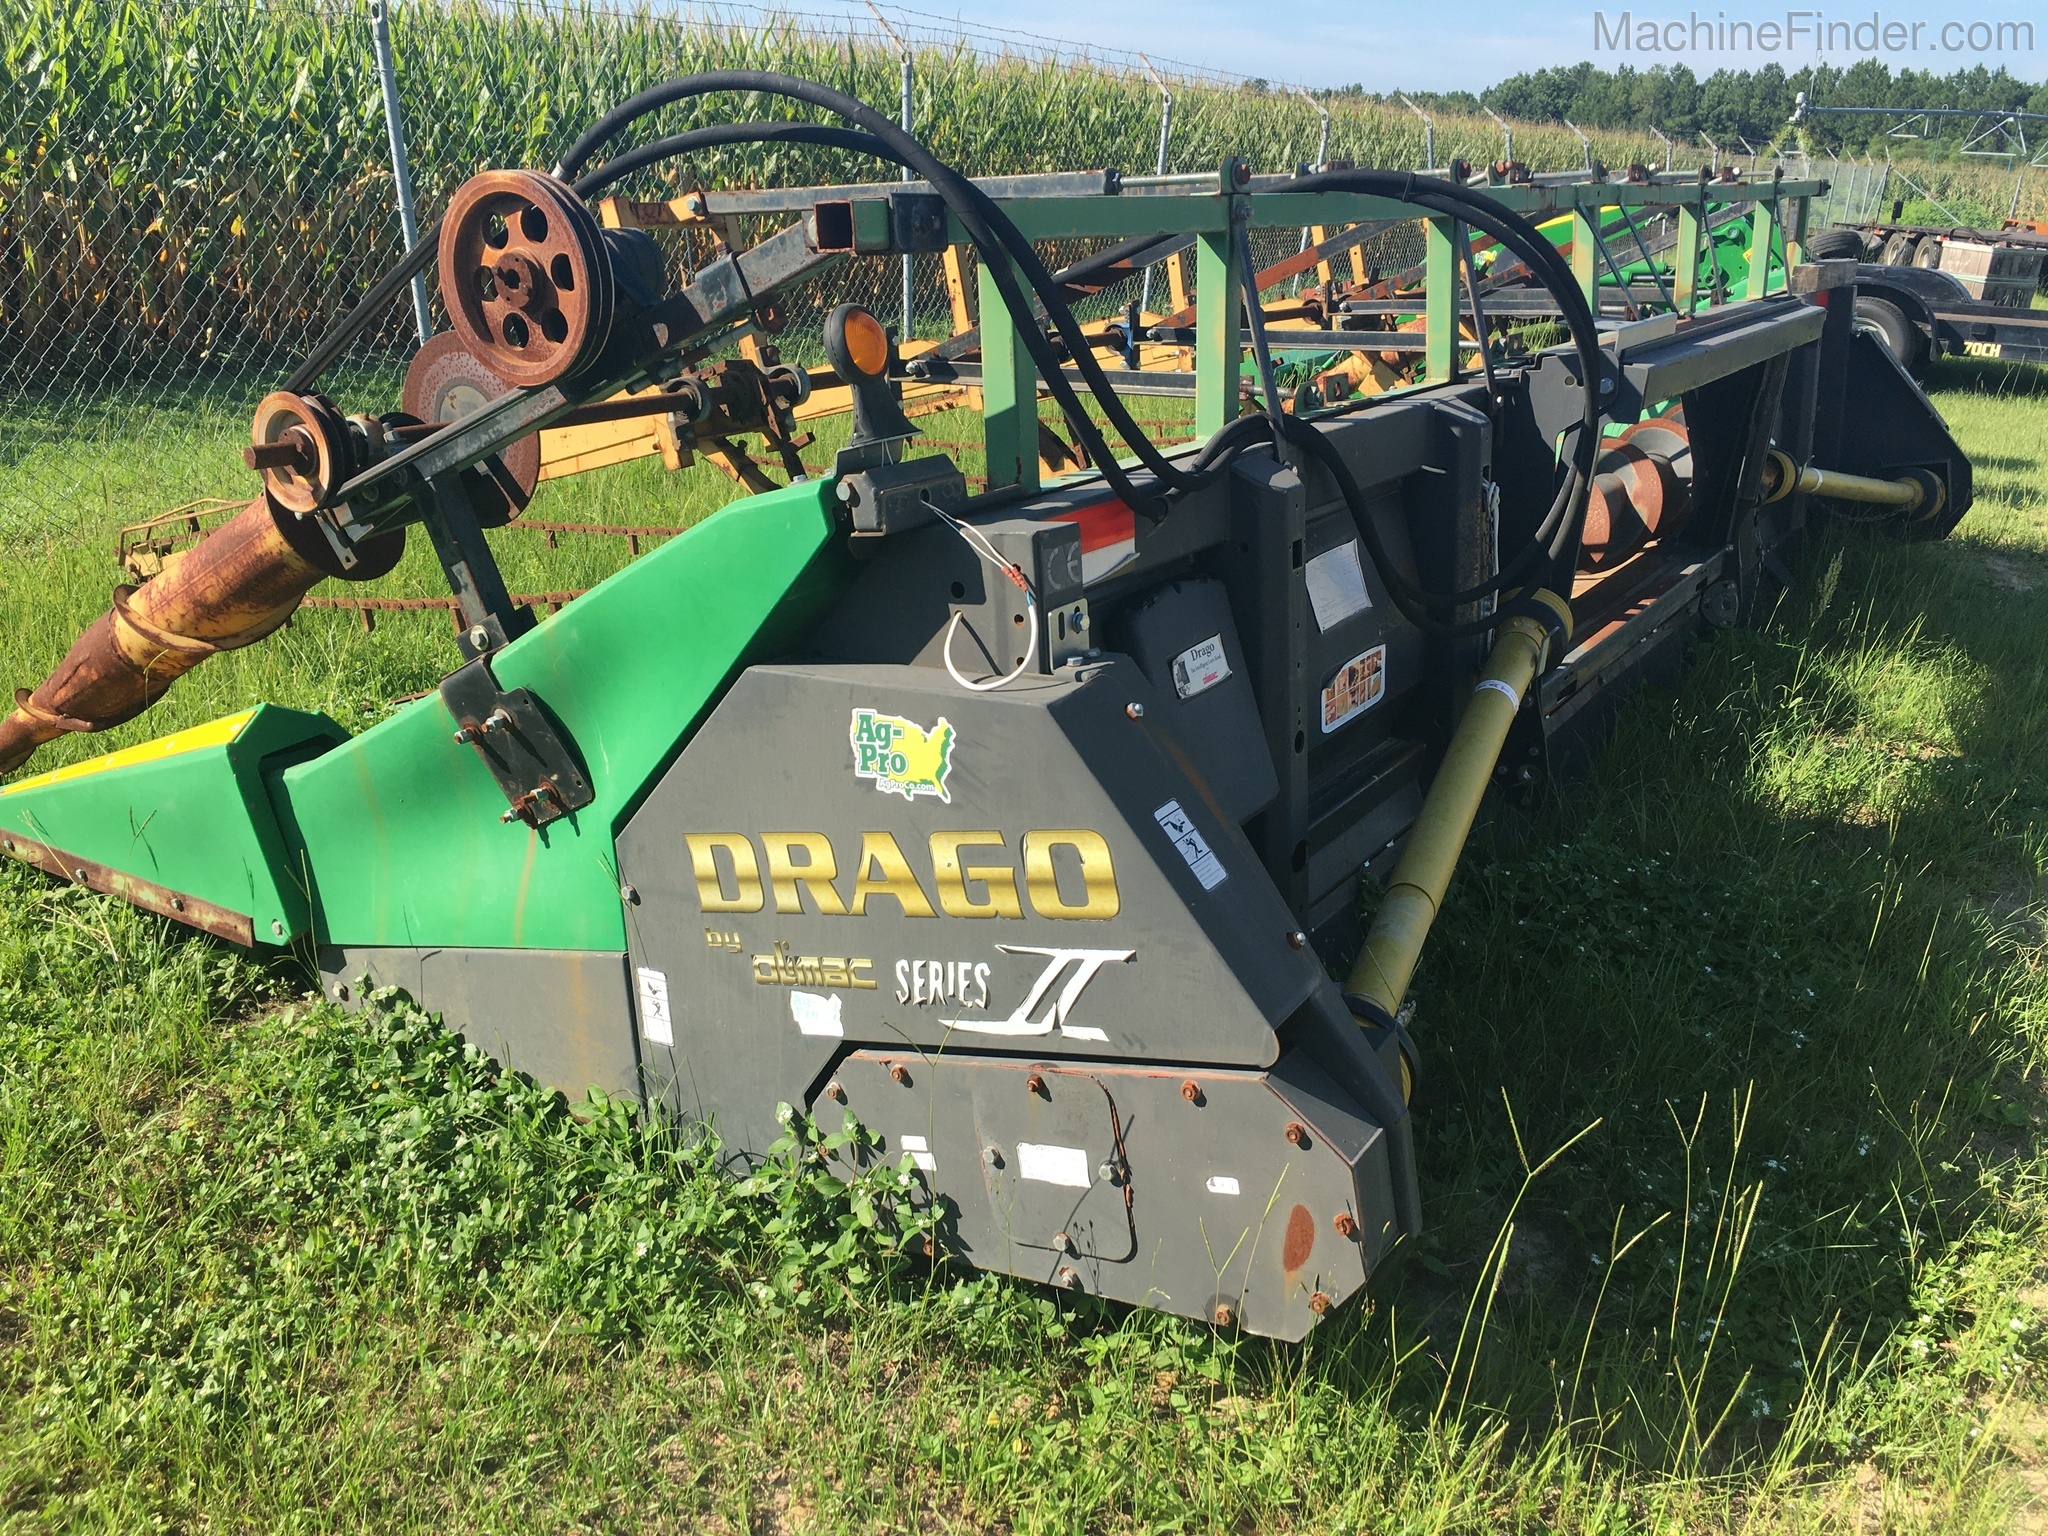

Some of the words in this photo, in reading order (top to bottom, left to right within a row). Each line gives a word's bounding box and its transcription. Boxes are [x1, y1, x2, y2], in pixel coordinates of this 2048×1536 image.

[1190, 643, 1215, 661] Drago
[856, 713, 903, 750] Ag-
[858, 743, 907, 774] Pro
[879, 778, 936, 791] AgProCo.com
[684, 830, 1121, 921] DRAGO
[705, 926, 743, 953] by
[895, 958, 992, 1010] SERIES
[937, 944, 1137, 1042] II
